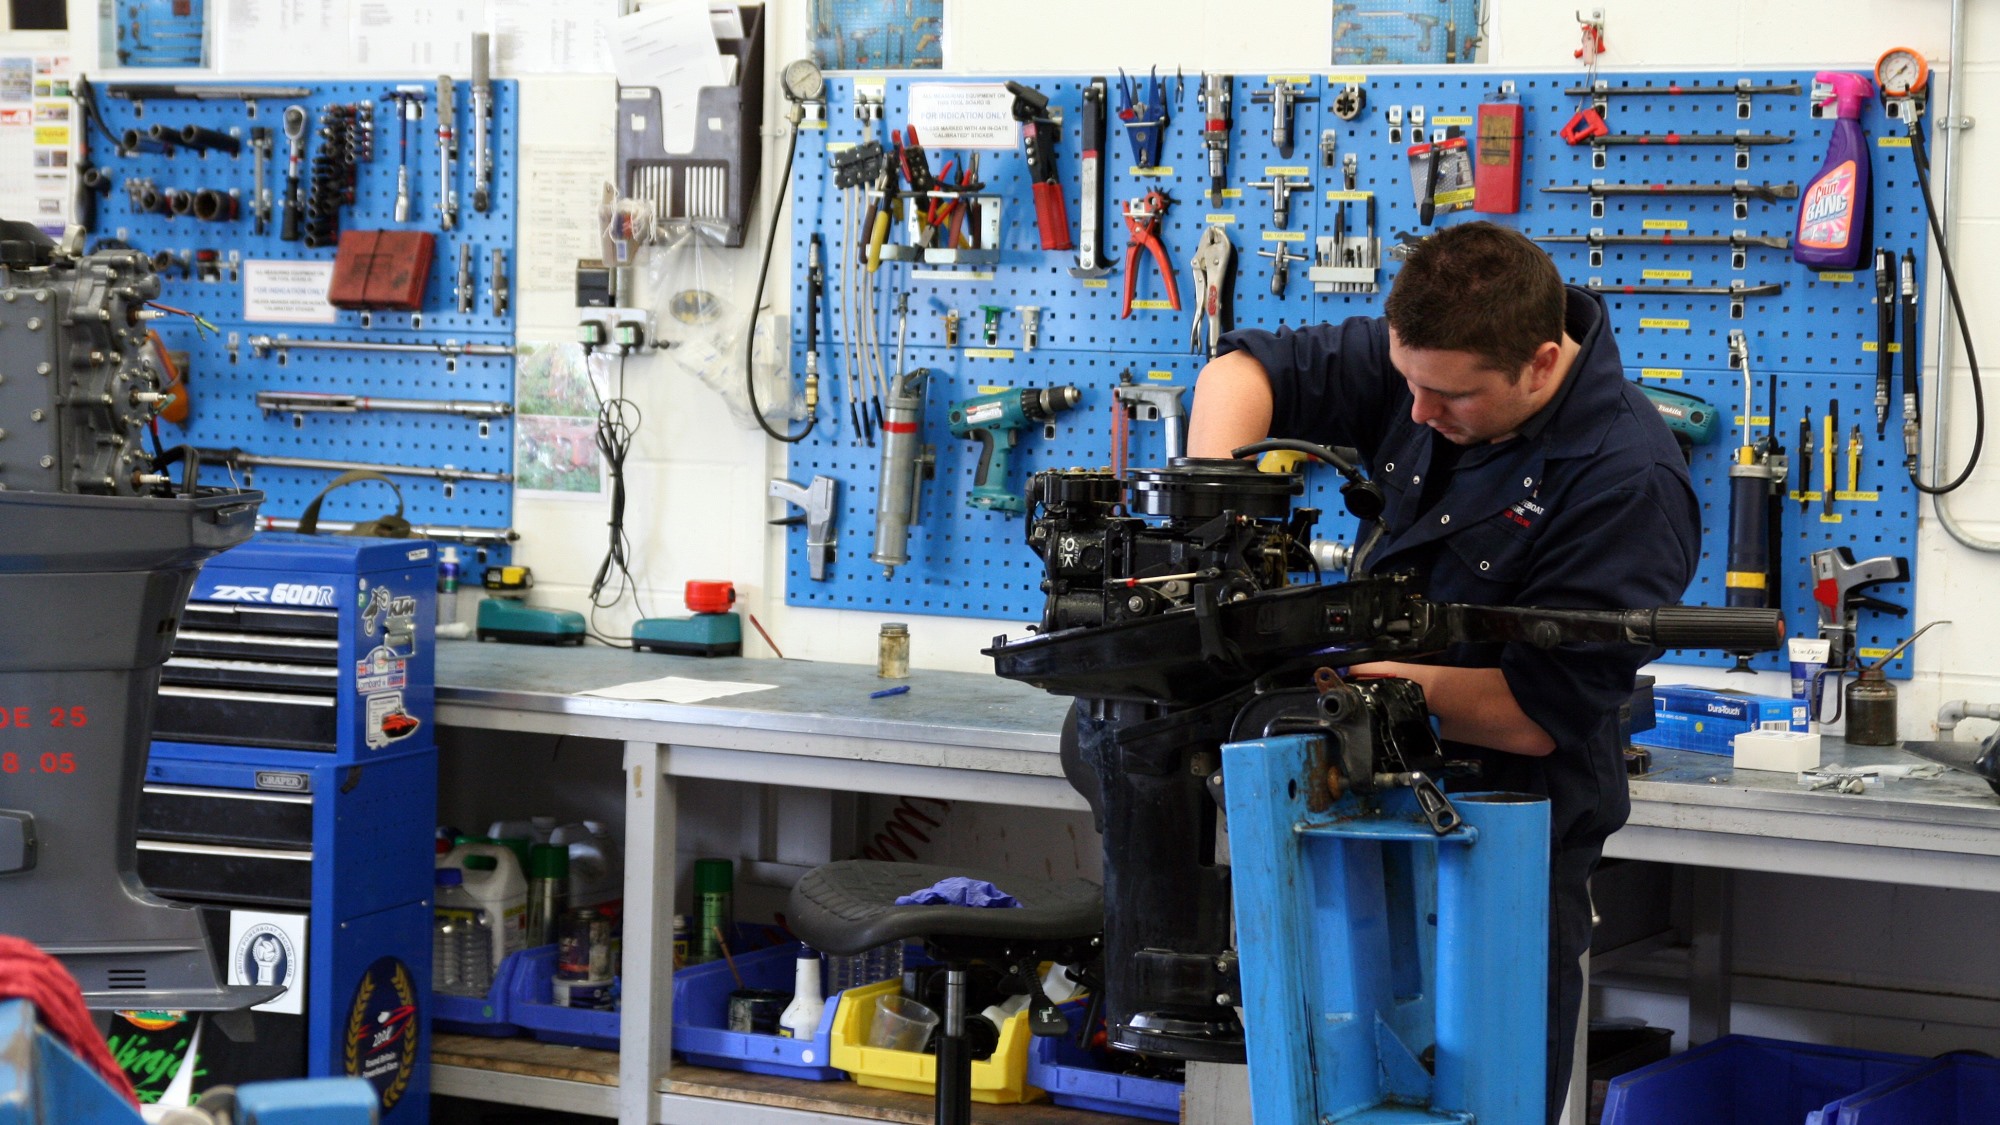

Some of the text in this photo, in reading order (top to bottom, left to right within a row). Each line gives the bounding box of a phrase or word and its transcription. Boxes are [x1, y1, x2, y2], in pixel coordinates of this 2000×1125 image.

[920, 111, 1007, 120] FOR INDICATION ONLY
[1815, 182, 1838, 205] CILLIT
[1805, 194, 1848, 223] BANG
[307, 287, 325, 295] ONLY
[1148, 371, 1172, 379] HACKSAW
[1642, 368, 1665, 376] BATTERY
[209, 583, 334, 606] ZXR 600R
[387, 595, 416, 618] KTM
[49, 706, 88, 728] 25
[262, 775, 298, 786] DRAPER
[286, 959, 294, 978] CLUB
